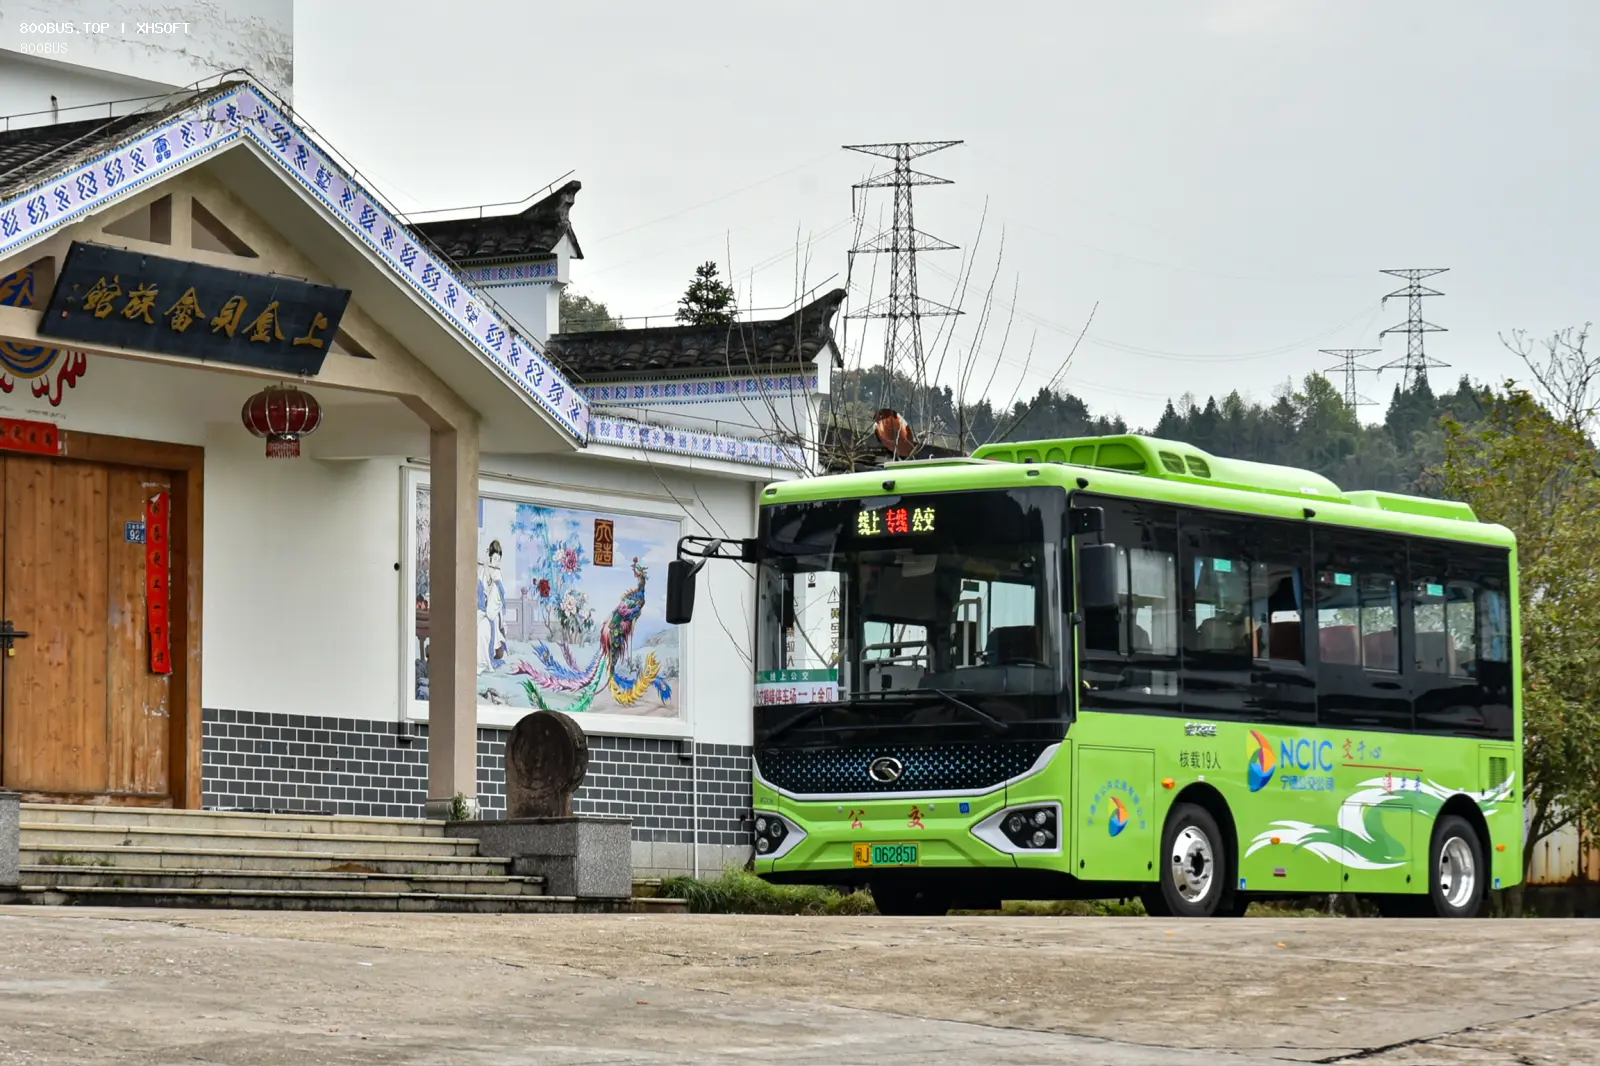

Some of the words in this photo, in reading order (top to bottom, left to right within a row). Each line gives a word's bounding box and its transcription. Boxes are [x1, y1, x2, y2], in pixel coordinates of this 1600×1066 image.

[1179, 751, 1221, 769] 核载19人
[1280, 738, 1334, 771] NCIC
